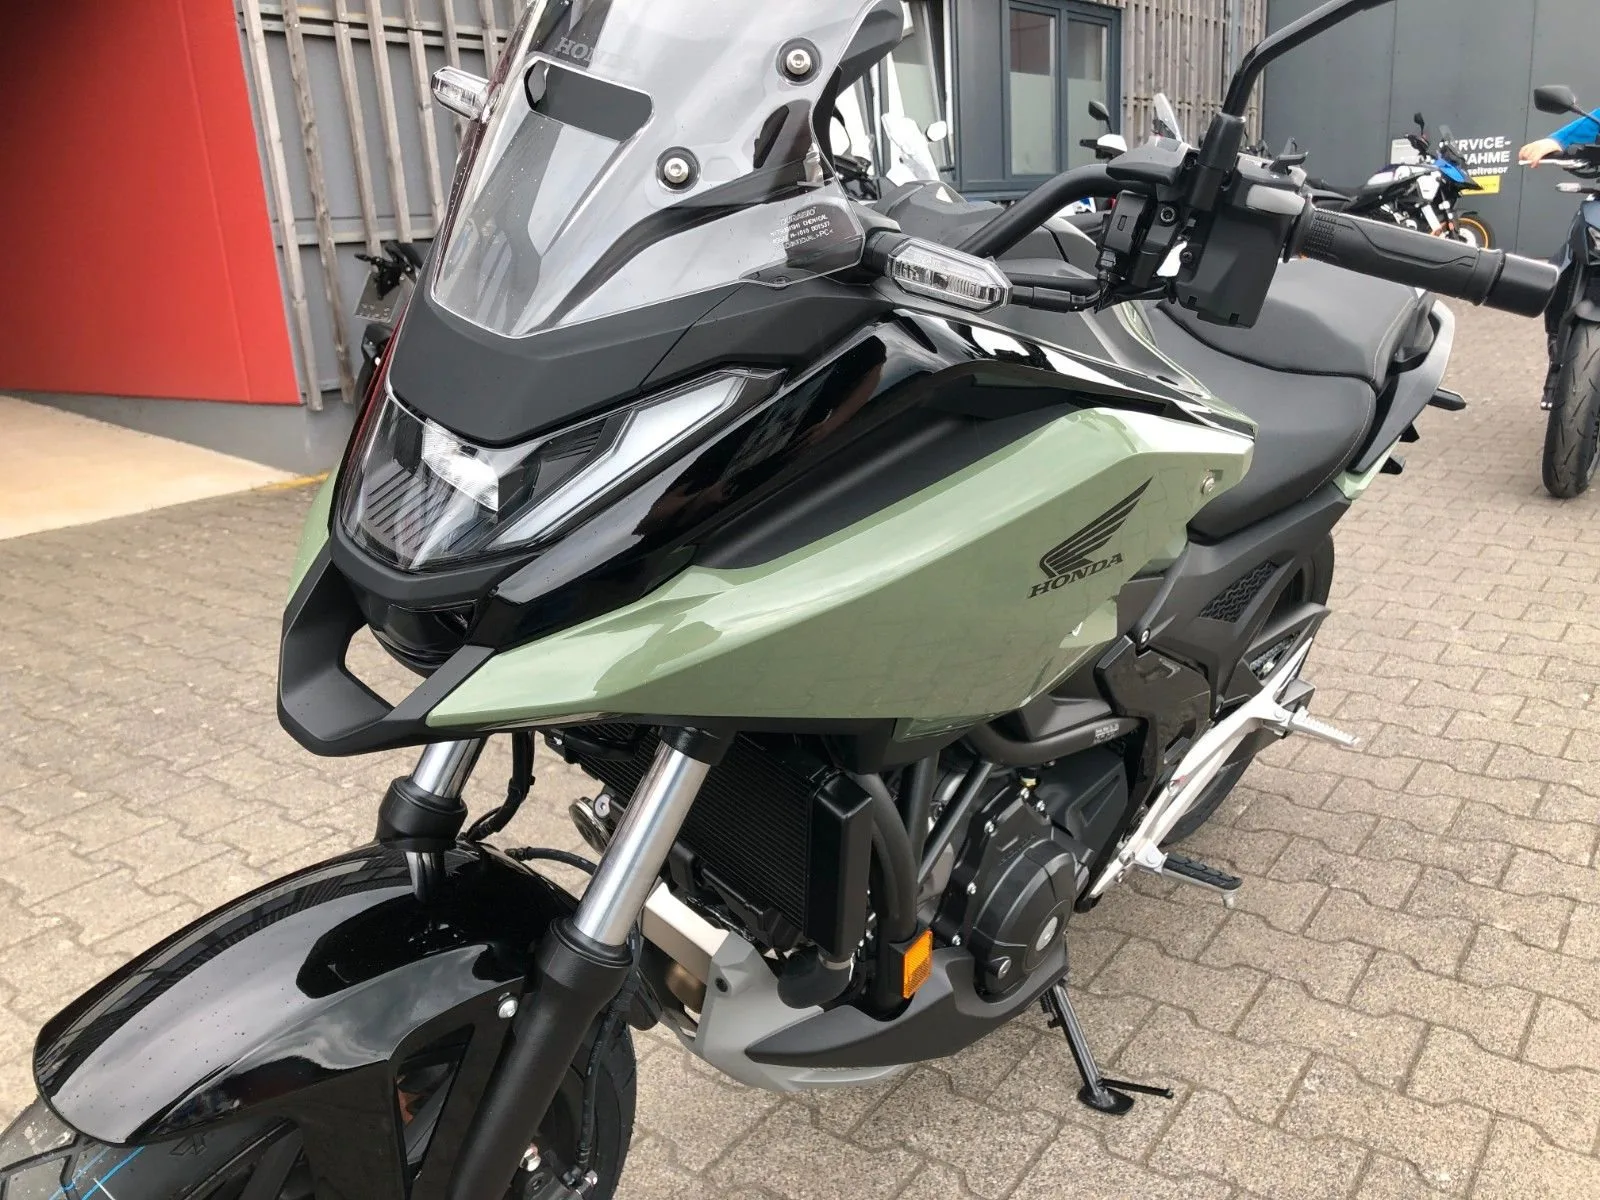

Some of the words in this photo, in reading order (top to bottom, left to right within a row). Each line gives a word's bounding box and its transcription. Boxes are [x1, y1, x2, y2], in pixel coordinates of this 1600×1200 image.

[1455, 136, 1512, 151] RVICE-
[1463, 150, 1511, 165] AHME
[1027, 552, 1123, 599] HONDA
